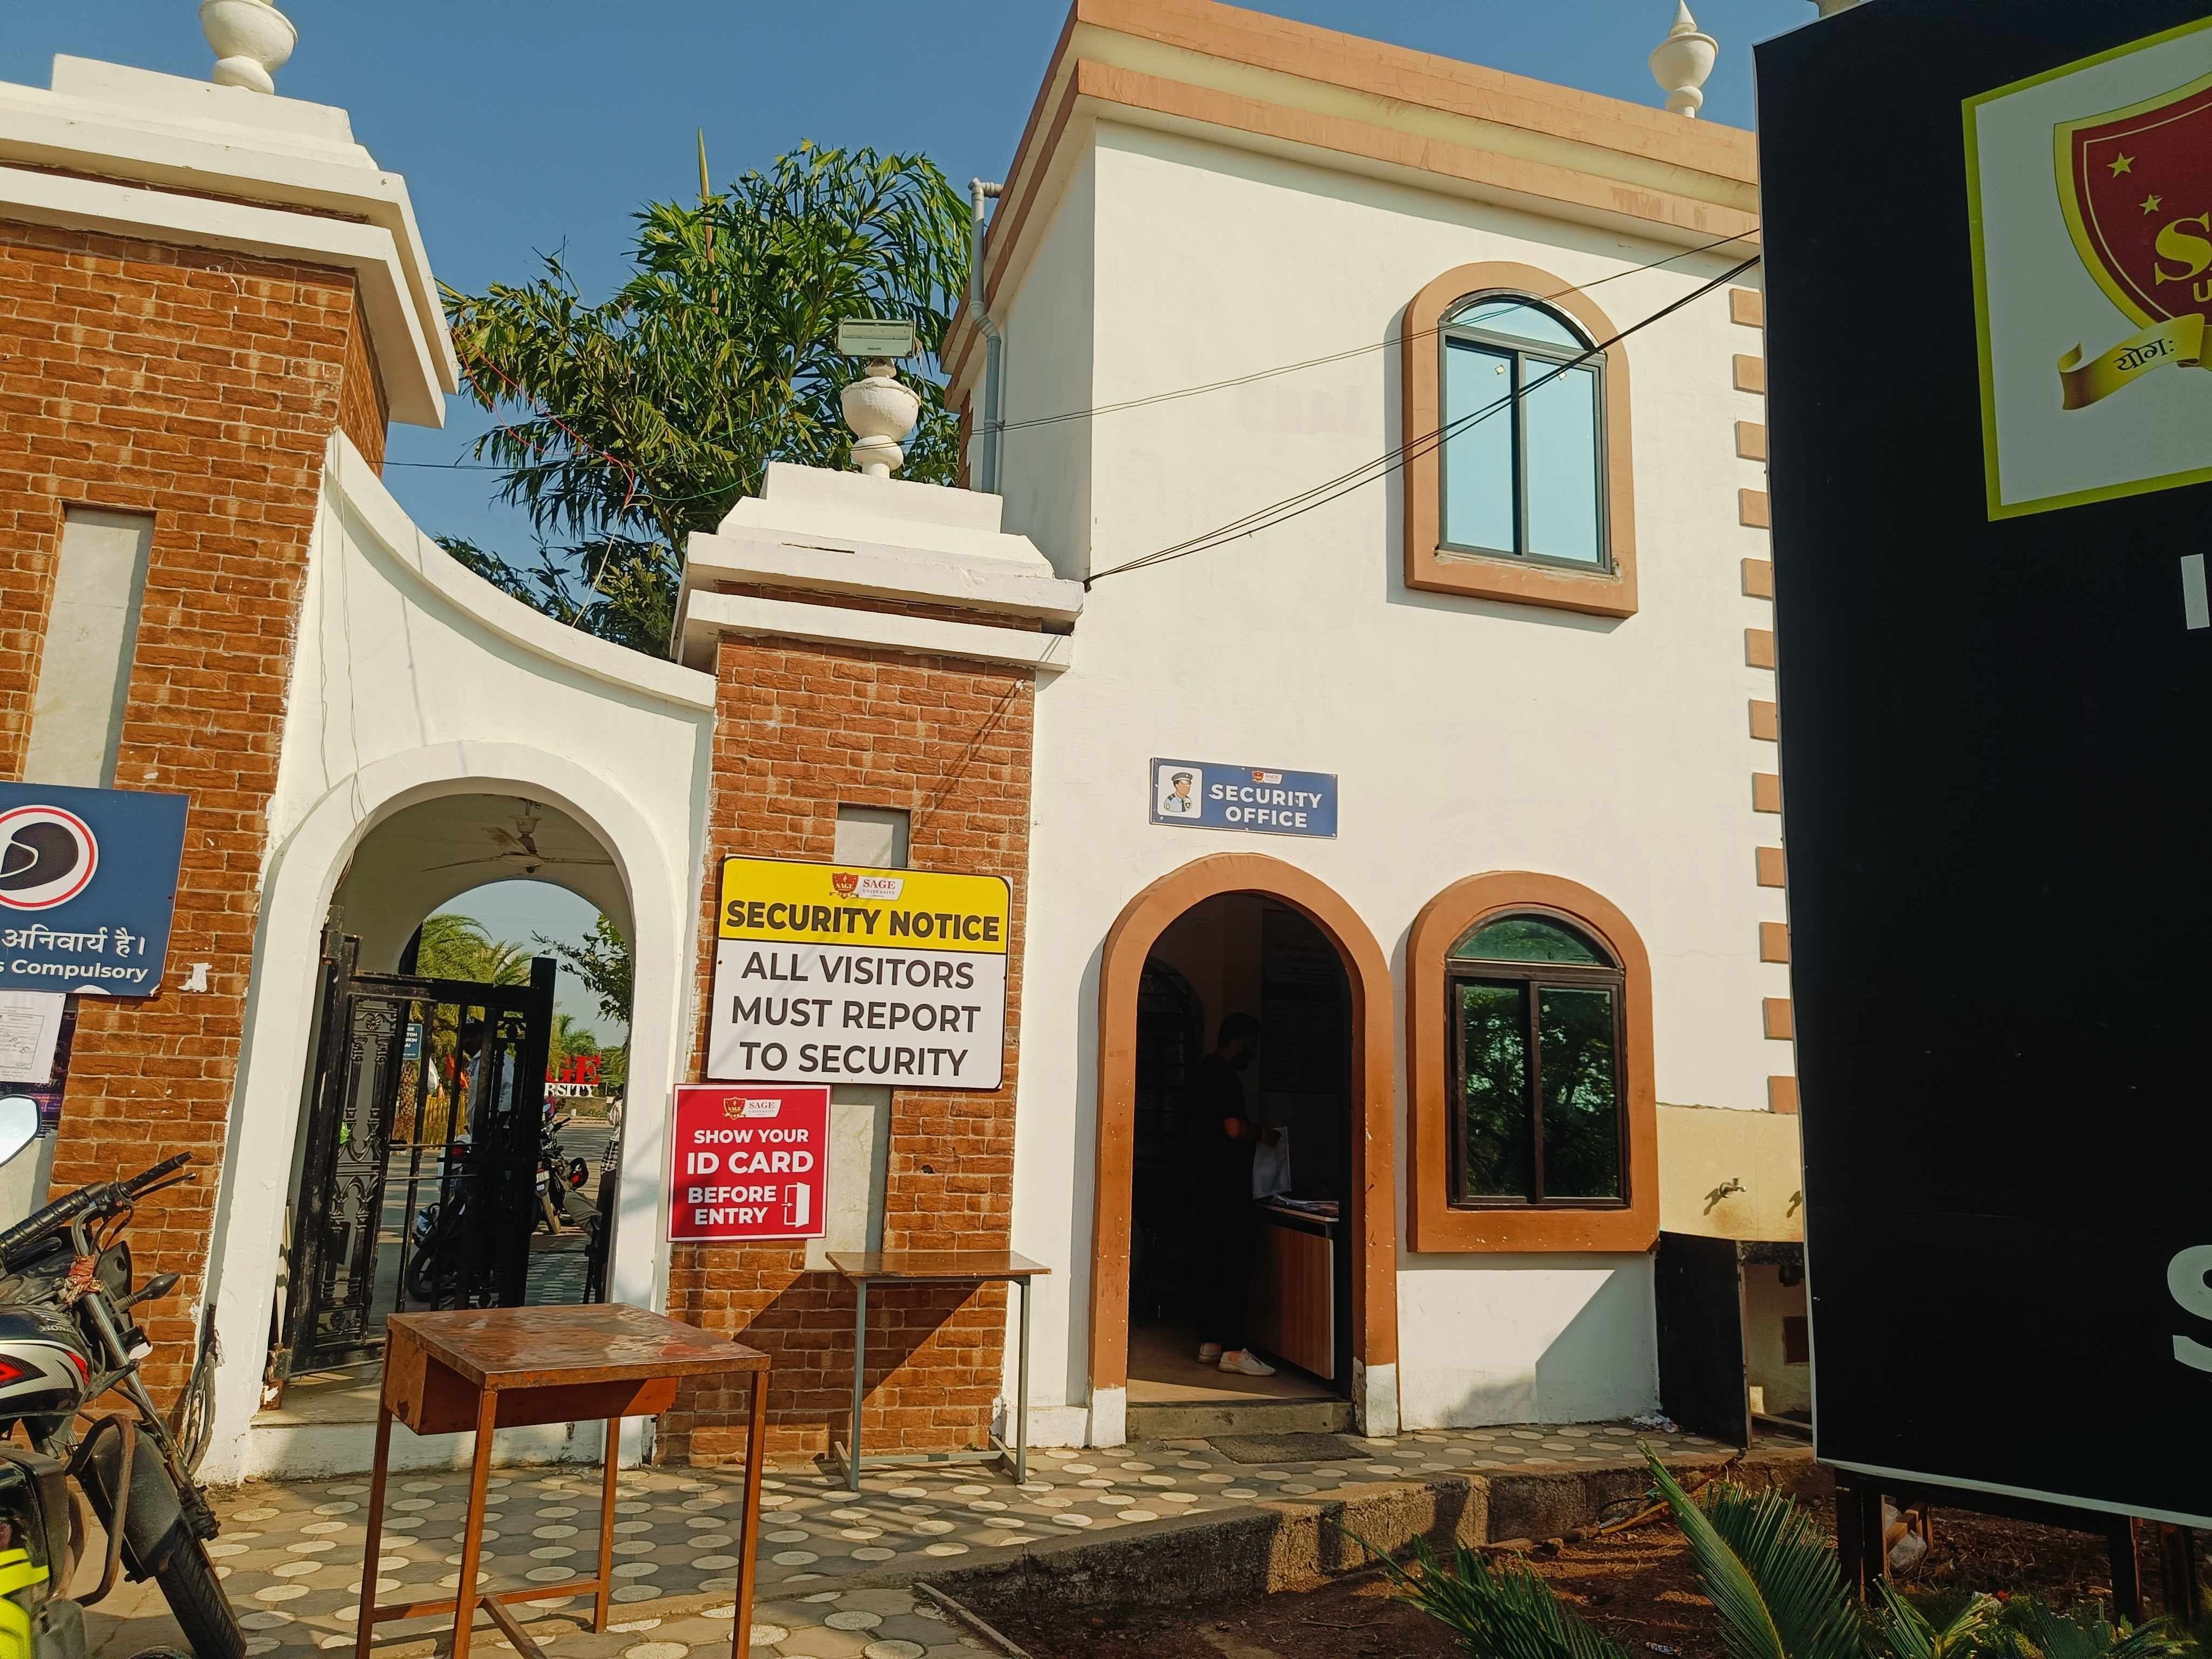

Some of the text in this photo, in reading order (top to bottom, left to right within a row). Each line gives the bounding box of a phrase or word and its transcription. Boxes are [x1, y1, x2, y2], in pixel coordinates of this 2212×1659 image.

[2155, 212, 2212, 286] S
[1208, 784, 1323, 808] SECURITY
[1225, 806, 1307, 828] OFFICE
[863, 879, 895, 889] SAGE
[726, 900, 1000, 941] SECURITY NOTICE
[2, 924, 108, 953] अनिवार्य
[11, 959, 149, 983] Compulsory
[741, 952, 974, 989] ALL VISITORS
[732, 996, 981, 1032] MUST REPORT
[740, 1042, 968, 1076] TO SECURITY
[693, 1129, 809, 1144] SHOW YOUR
[687, 1151, 814, 1175] ID CARD
[688, 1185, 777, 1204] BEFORE
[694, 1207, 768, 1225] ENTRY
